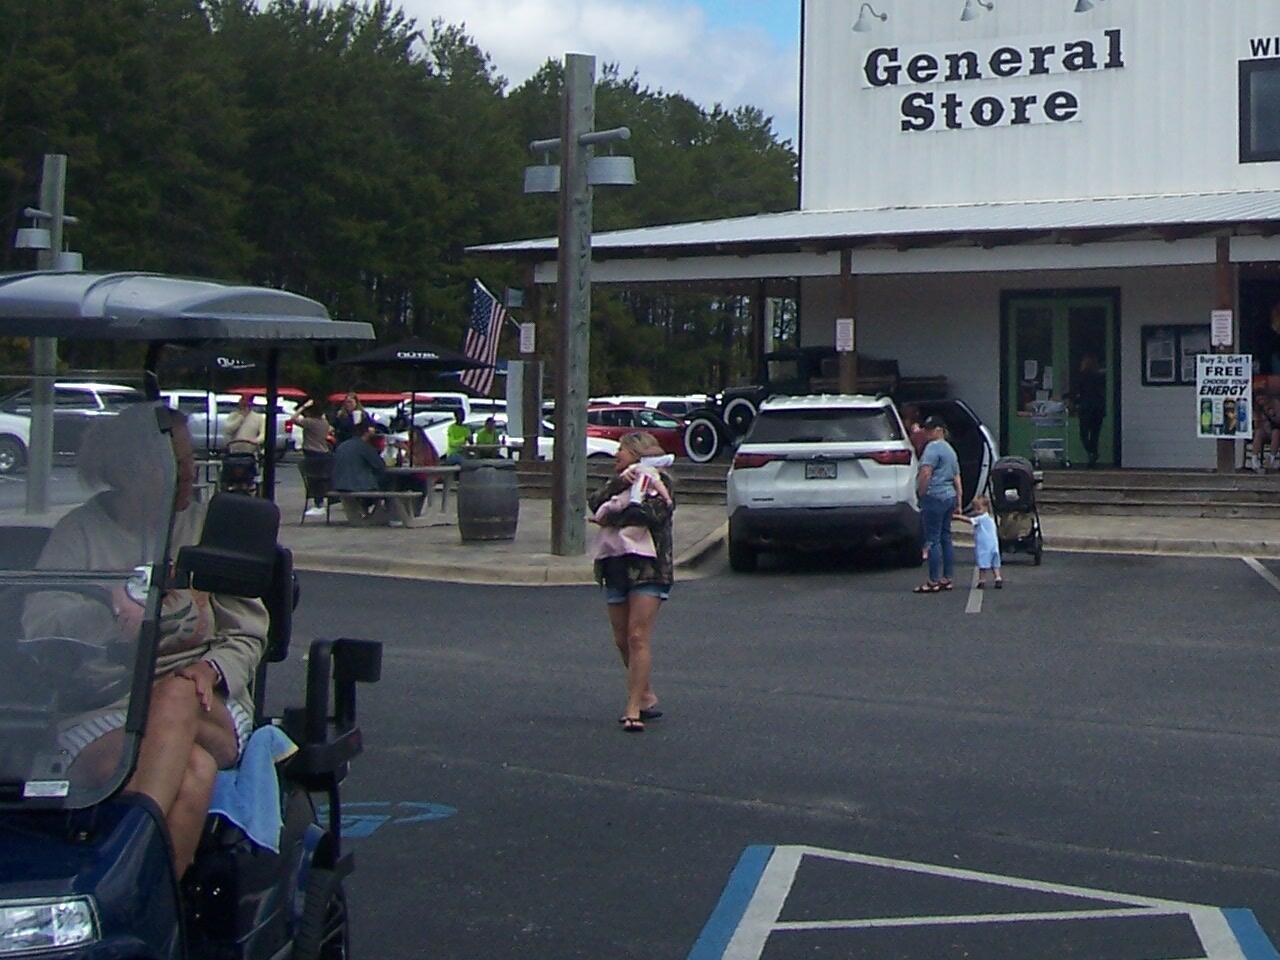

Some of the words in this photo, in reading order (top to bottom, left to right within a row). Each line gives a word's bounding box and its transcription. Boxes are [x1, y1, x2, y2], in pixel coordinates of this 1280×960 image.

[863, 28, 1124, 87] General
[900, 90, 1078, 132] Store
[1200, 356, 1214, 364] Buy
[1205, 366, 1243, 376] FREE
[1199, 385, 1247, 395] ENERGY
